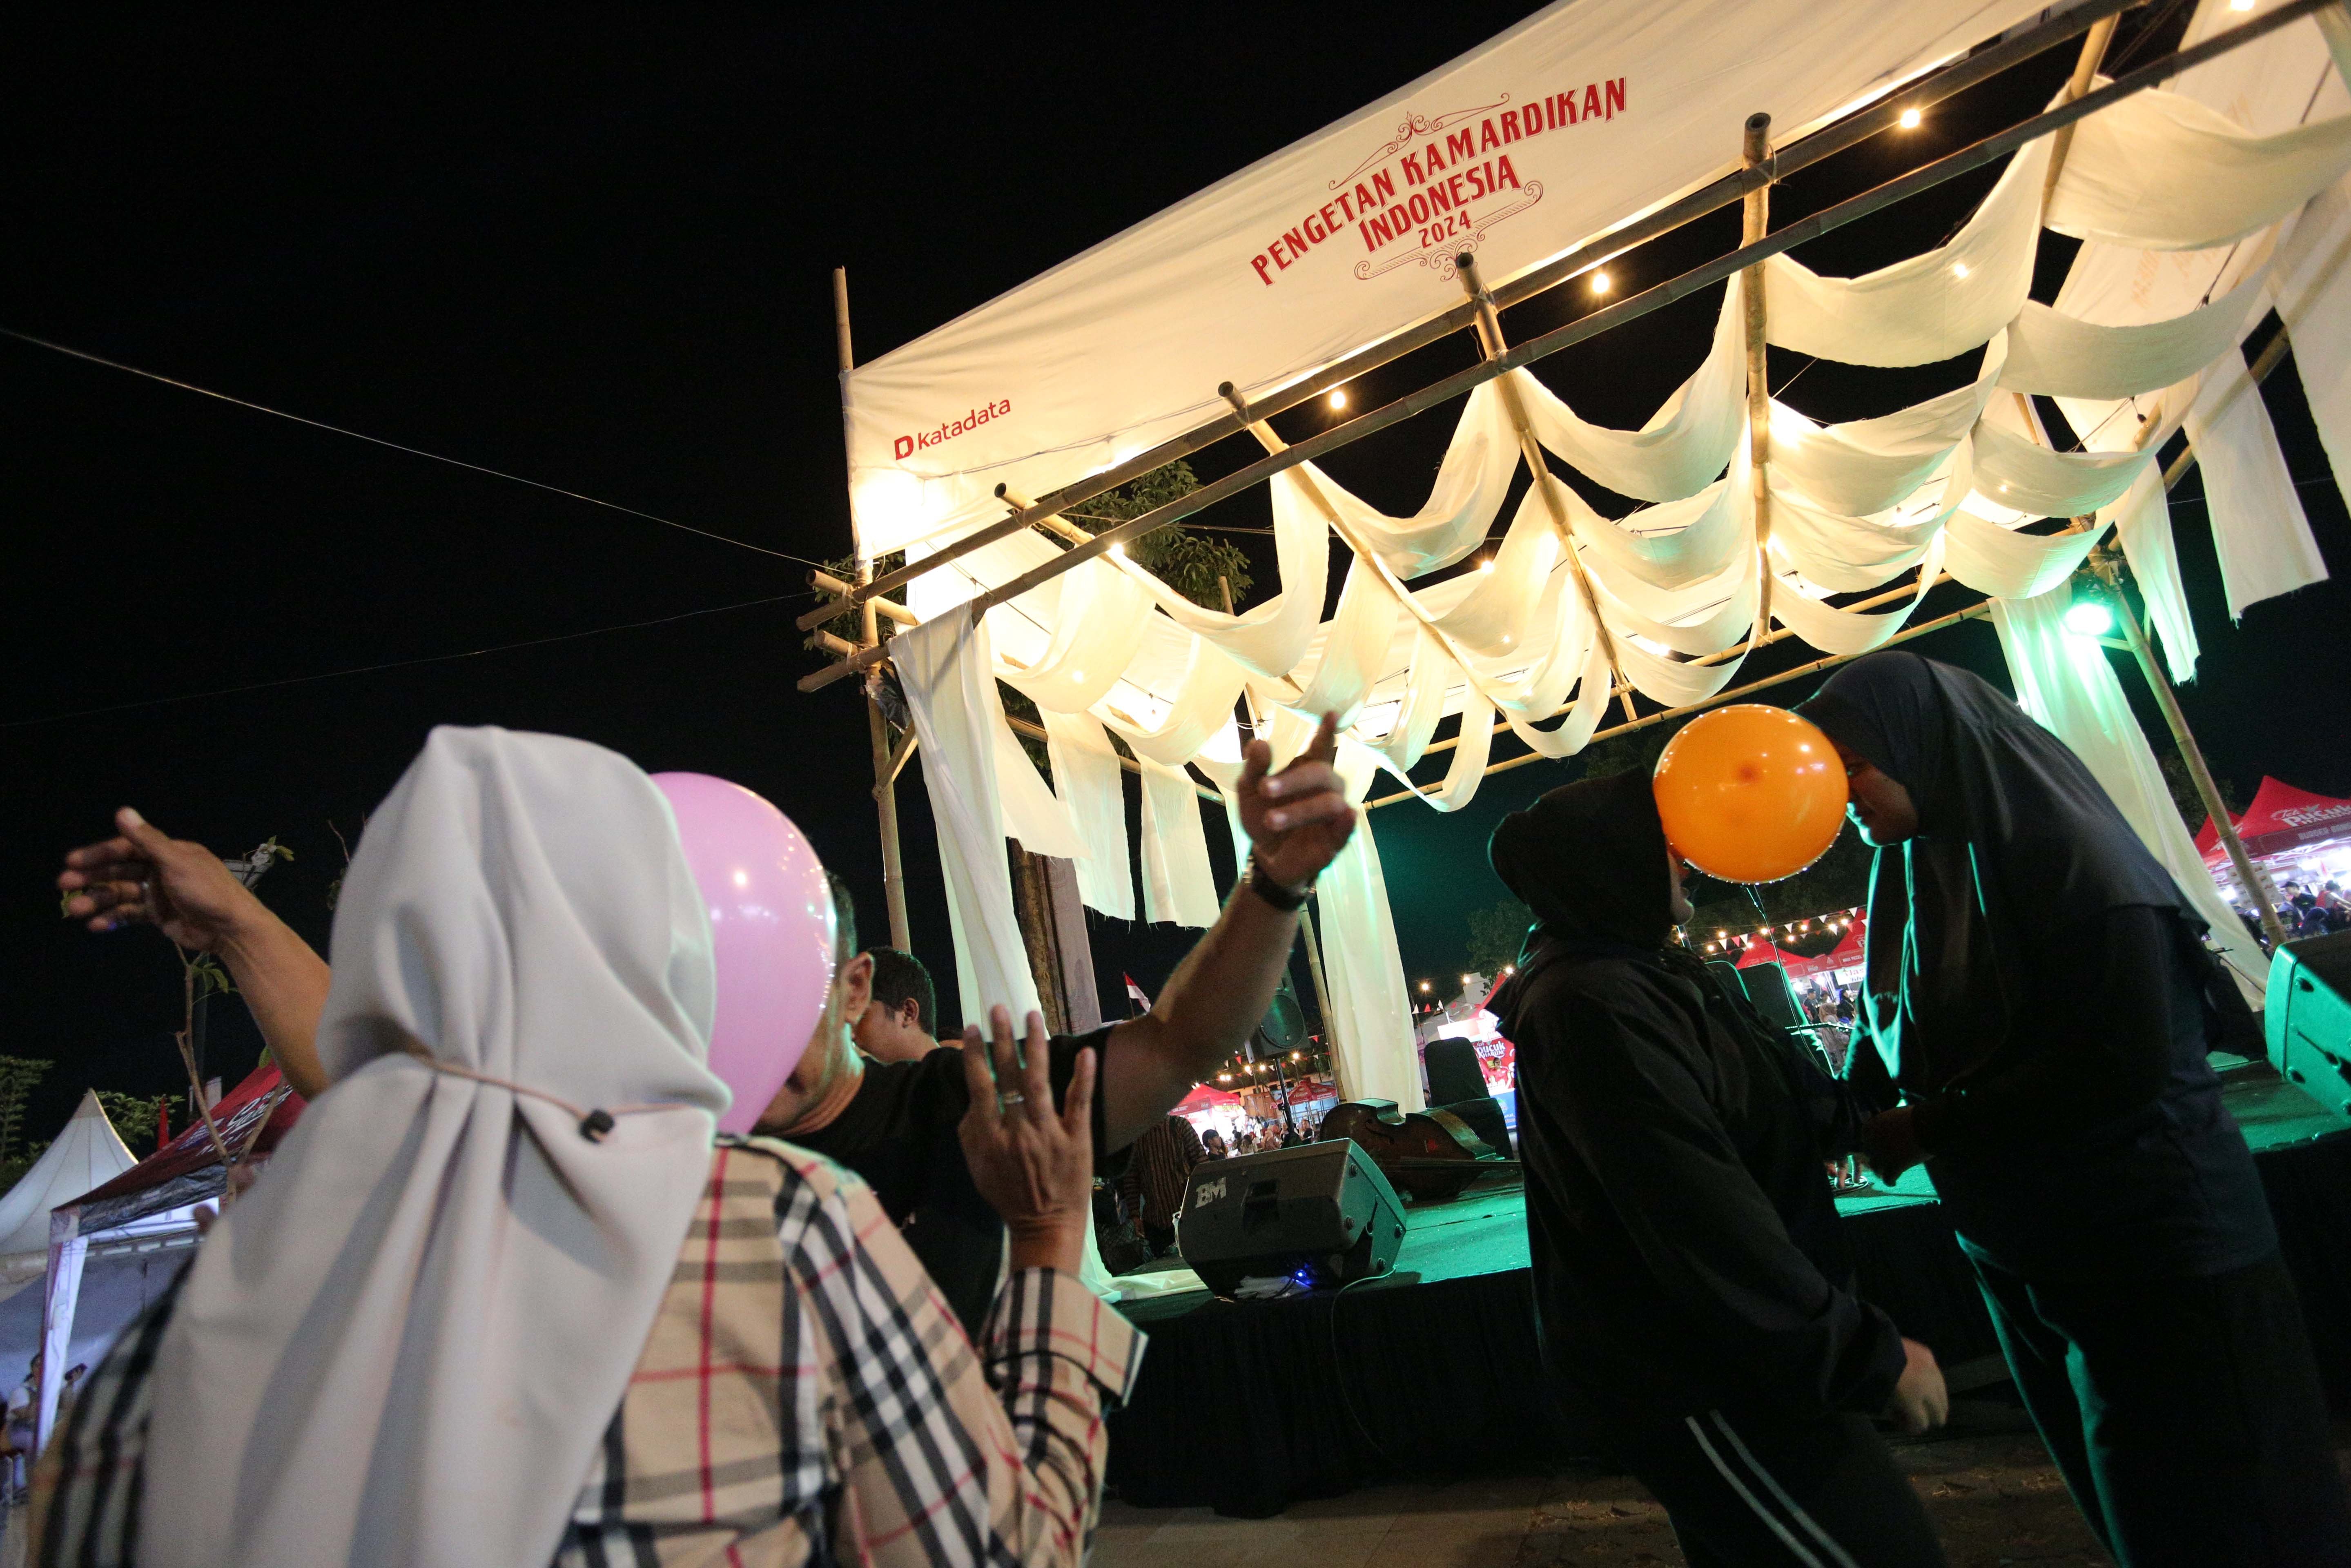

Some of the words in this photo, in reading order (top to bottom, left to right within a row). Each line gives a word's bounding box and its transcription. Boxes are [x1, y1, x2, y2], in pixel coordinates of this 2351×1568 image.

[1250, 167, 1394, 287] PENGETAN
[1401, 77, 1627, 189] KAMARDIKAN
[1358, 154, 1522, 254] INDONESIA
[1419, 210, 1472, 249] 2024
[918, 399, 1011, 450] katadata
[1195, 1177, 1226, 1208] BM
